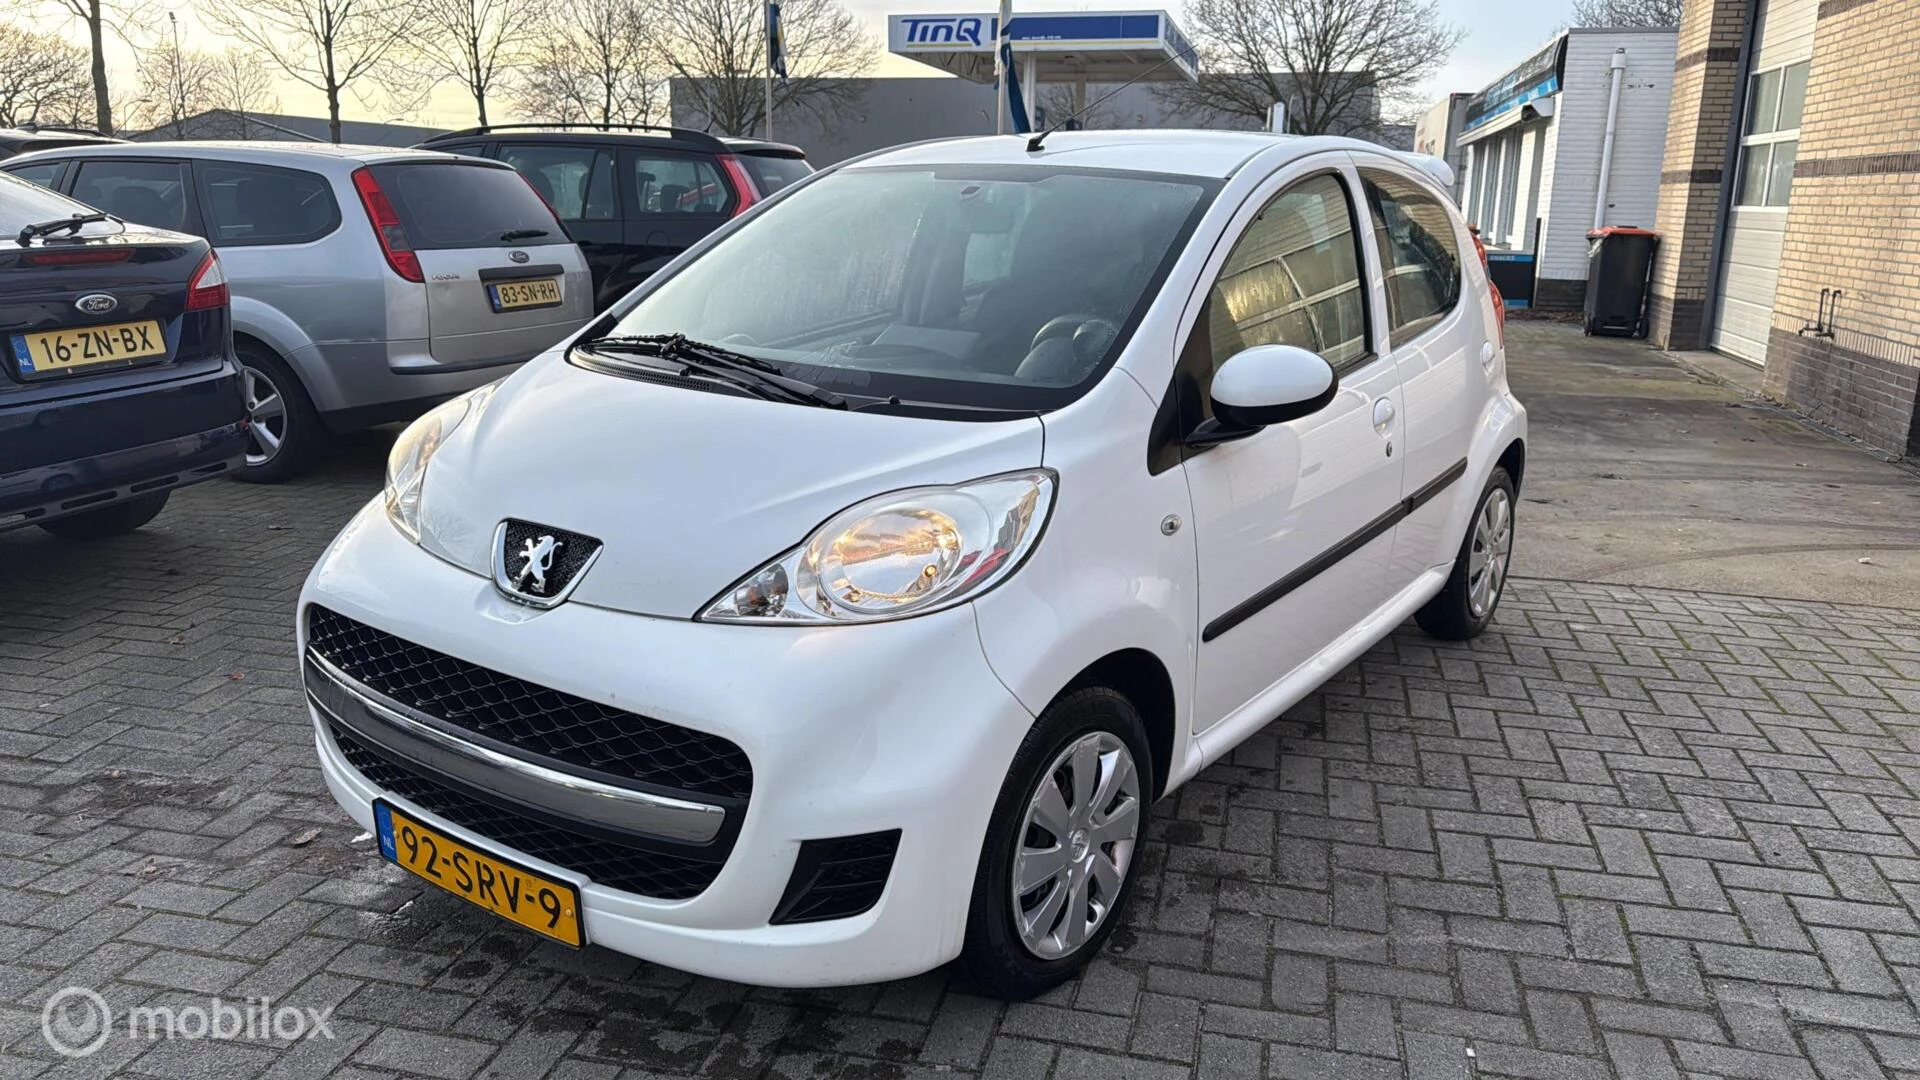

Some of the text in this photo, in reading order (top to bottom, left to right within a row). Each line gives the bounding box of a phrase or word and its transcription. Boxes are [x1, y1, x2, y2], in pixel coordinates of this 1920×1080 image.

[501, 284, 557, 304] 83-SN-RH
[87, 298, 110, 310] Ford
[40, 325, 154, 364] 16-ZN-BX
[18, 358, 32, 367] NL
[382, 835, 395, 851] NL
[401, 825, 561, 929] 92-SRV-9
